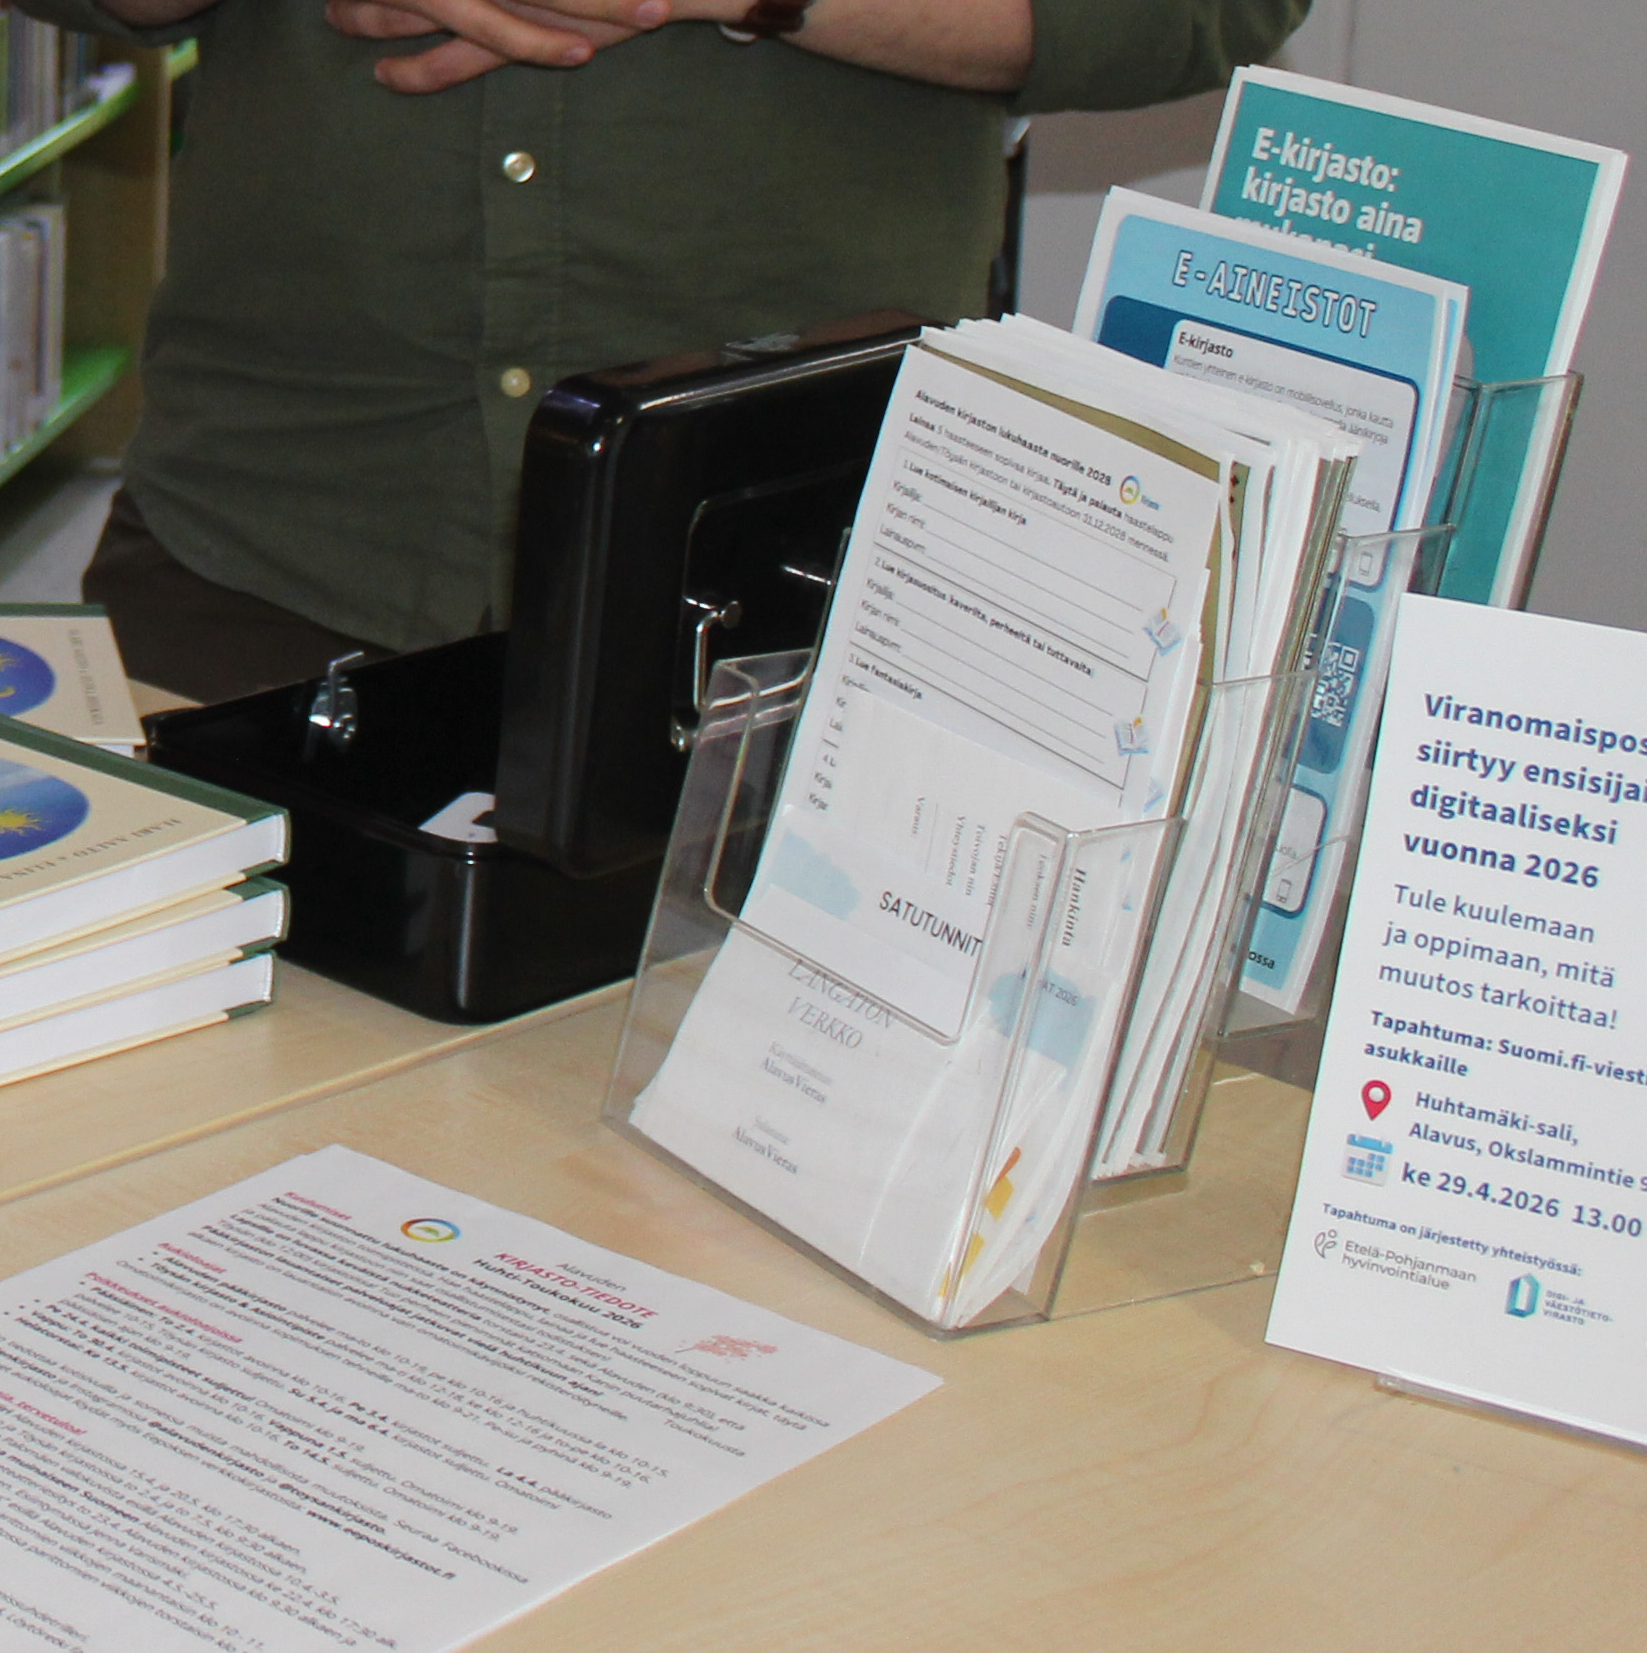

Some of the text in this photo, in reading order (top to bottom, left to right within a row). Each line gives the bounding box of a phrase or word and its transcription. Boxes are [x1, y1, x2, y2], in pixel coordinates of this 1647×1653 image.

[1252, 127, 1400, 192] E-kirjasto:
[1241, 167, 1352, 226] kirjasto
[1356, 204, 1424, 244] aina
[1172, 250, 1379, 339] E-AINEISTOT
[1179, 331, 1235, 358] E-kirjasto
[915, 389, 1086, 475] Alavuden kirjaston lukuhaaste nuorille
[909, 412, 936, 432] Lainaa
[1053, 478, 1079, 498] Täytä
[1077, 490, 1088, 503] ja
[1088, 497, 1123, 519] palauta
[909, 462, 1028, 526] Lue kotimaisen kirjailijan kirja
[881, 560, 896, 574] Lue
[1032, 638, 1046, 652] tai
[856, 658, 870, 672] Lue
[1417, 740, 1517, 782] siirtyy
[1411, 785, 1617, 844] digitaaliseksi
[1404, 834, 1599, 888] vuonna 2026
[879, 890, 984, 958] SATUTUNNIT
[1394, 884, 1595, 943] Tule kuulemaan
[1381, 921, 1616, 988] ja oppimaan, mitä
[787, 996, 864, 1049] VERKKO
[788, 959, 895, 1029] LANGATON
[1379, 965, 1618, 1029] muutos tarkoittaa!
[1364, 1043, 1469, 1077] asukkaille
[1372, 1010, 1647, 1083] Tapahtuma: Suomi.fi-viest
[1416, 1092, 1578, 1145] Huhtamäki-sali,
[732, 1126, 799, 1174] AlavusVieras
[1409, 1122, 1635, 1188] Alavus, Okslammintie
[1401, 1162, 1642, 1237] ke 29.4.2026 13.00
[157, 1242, 227, 1274] Aukioloajat
[162, 1256, 220, 1283] Alavuden
[1323, 1203, 1582, 1276] Tapahtuma on järjestetty yhteistyössä:
[1345, 1240, 1477, 1282] Etelä-Pohjanmaan
[473, 1259, 643, 1330] Huhti-Toukokuu 2026
[495, 1253, 657, 1318] KIRJASTO-TIEDOTE
[555, 1263, 627, 1292] Alavuden
[1342, 1253, 1450, 1290] hyvinvointialue
[44, 1304, 63, 1314] Pe
[1543, 1309, 1587, 1326] VIRASTO
[1545, 1300, 1613, 1323] VÄESTÖTIETO-
[307, 1510, 456, 1580] www.eeposkirjastot.fi
